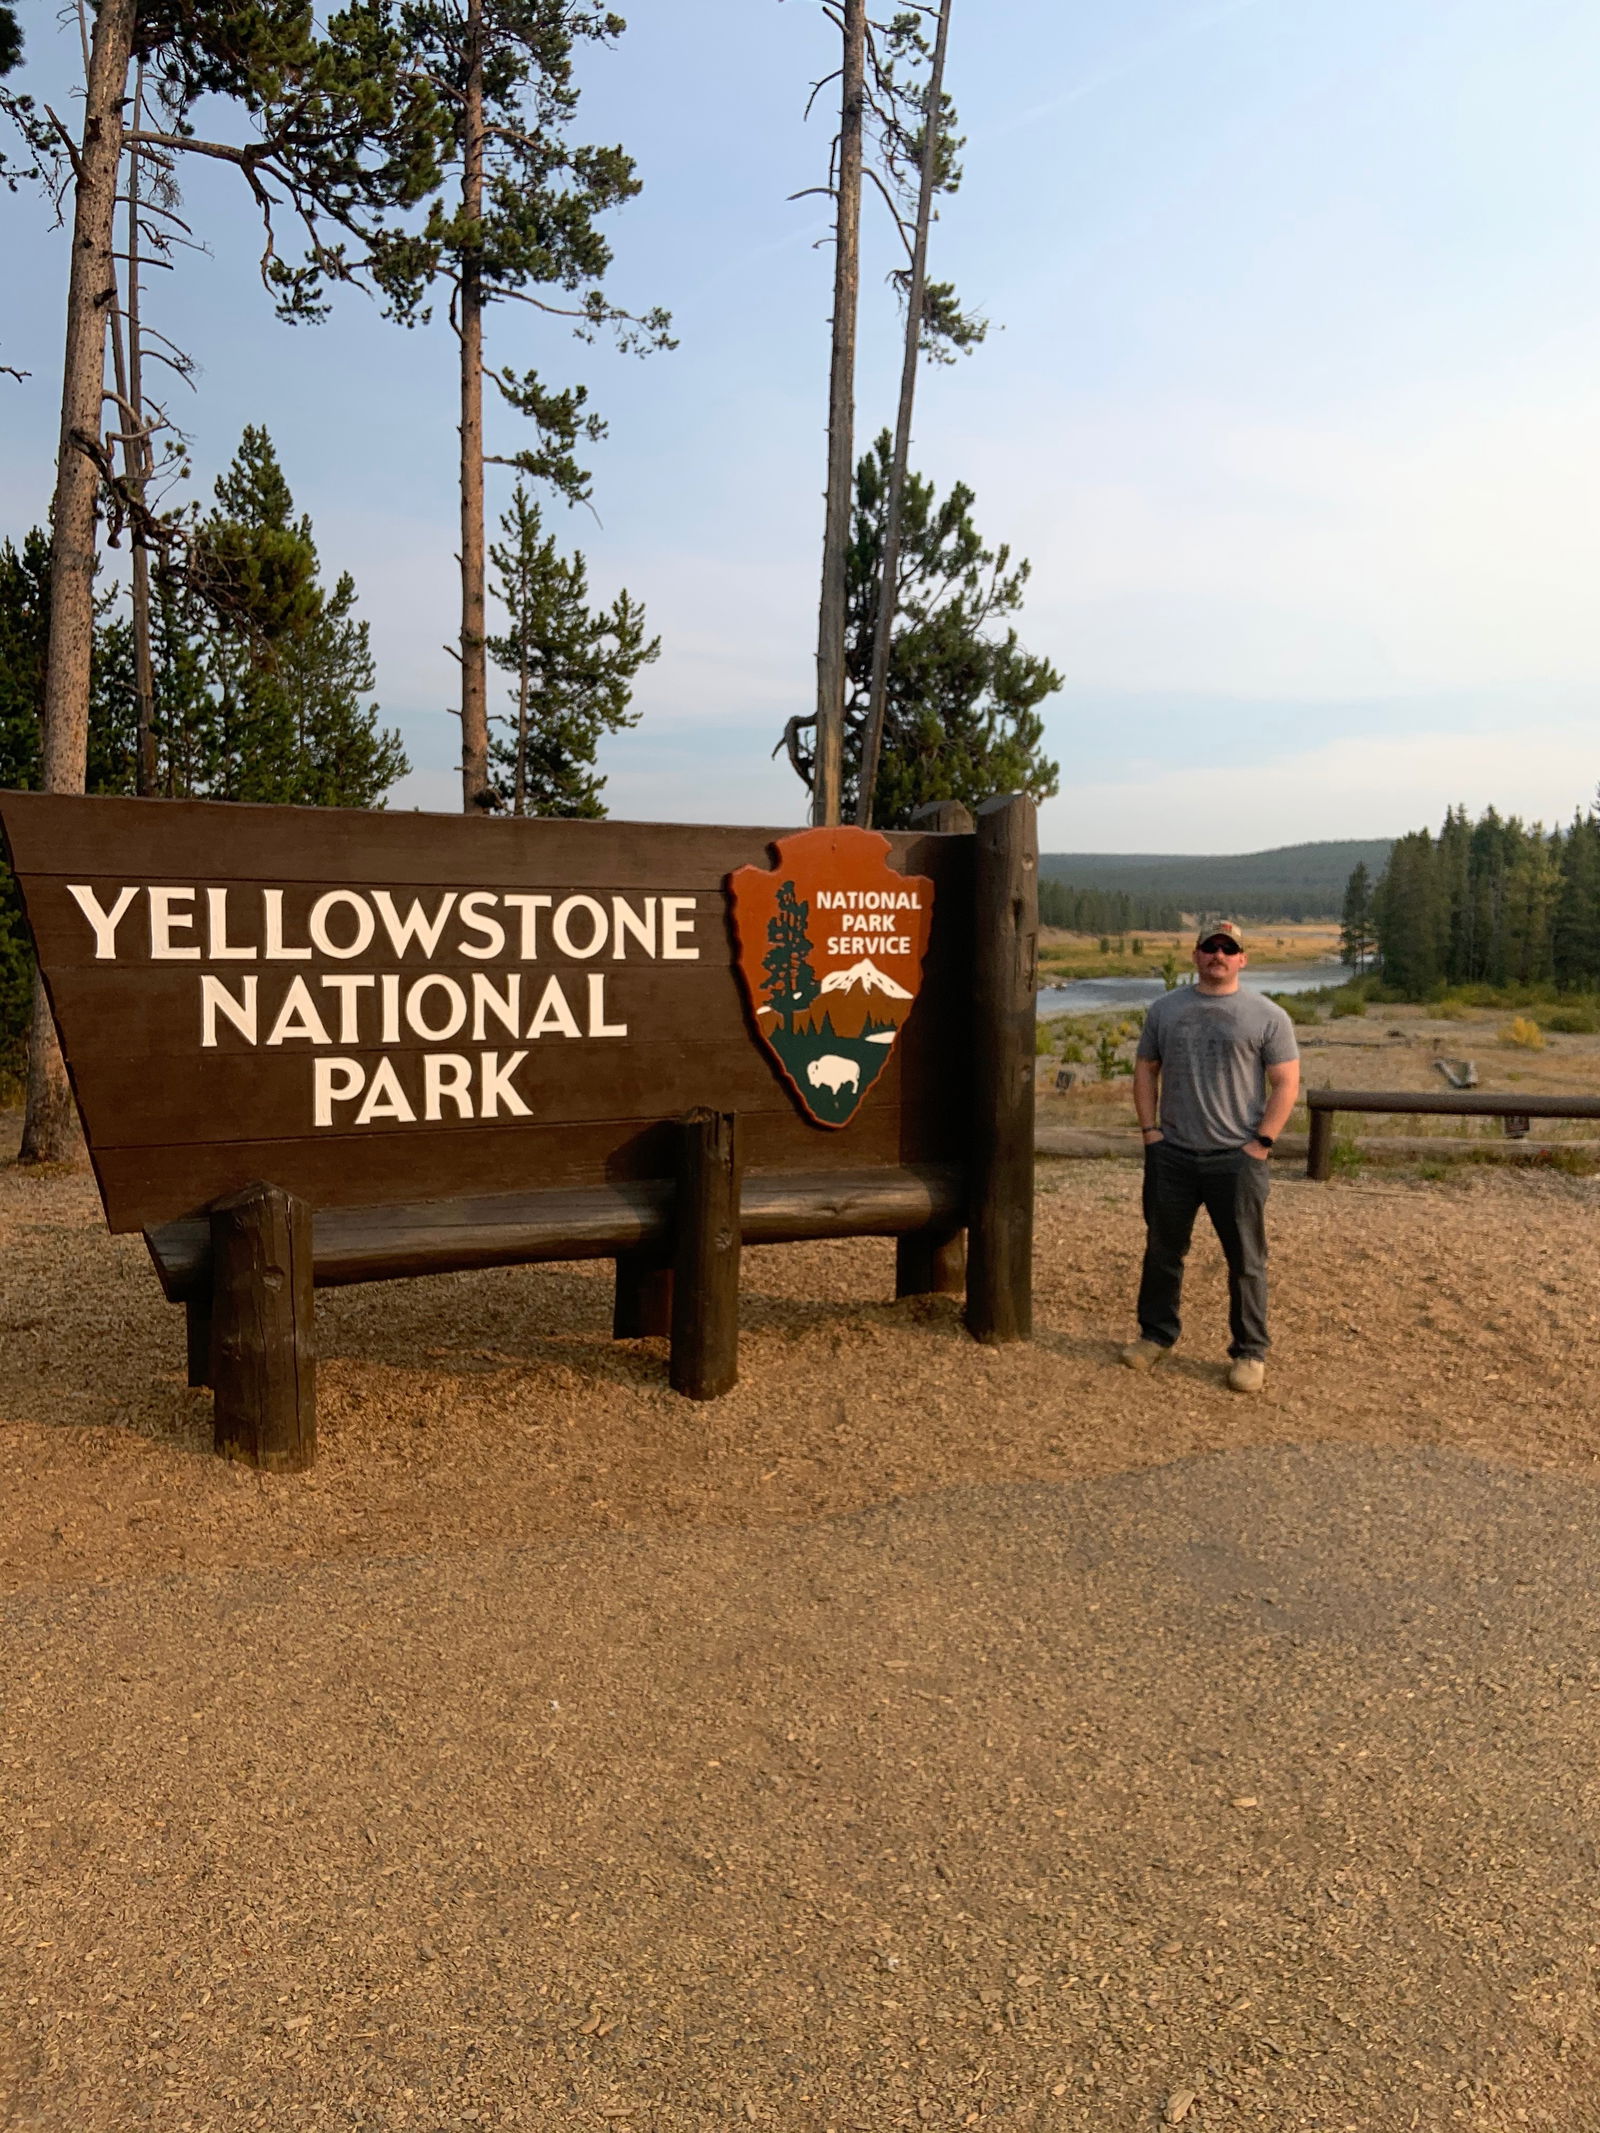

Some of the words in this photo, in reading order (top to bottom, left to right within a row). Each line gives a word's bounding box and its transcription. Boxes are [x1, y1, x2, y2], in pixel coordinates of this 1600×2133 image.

[67, 885, 700, 960] YELLOWSTONE
[816, 891, 922, 910] NATIONAL
[842, 914, 896, 932] PARK
[827, 937, 911, 954] SERVICE
[201, 974, 628, 1046] NATIONAL
[314, 1052, 532, 1126] PARK
